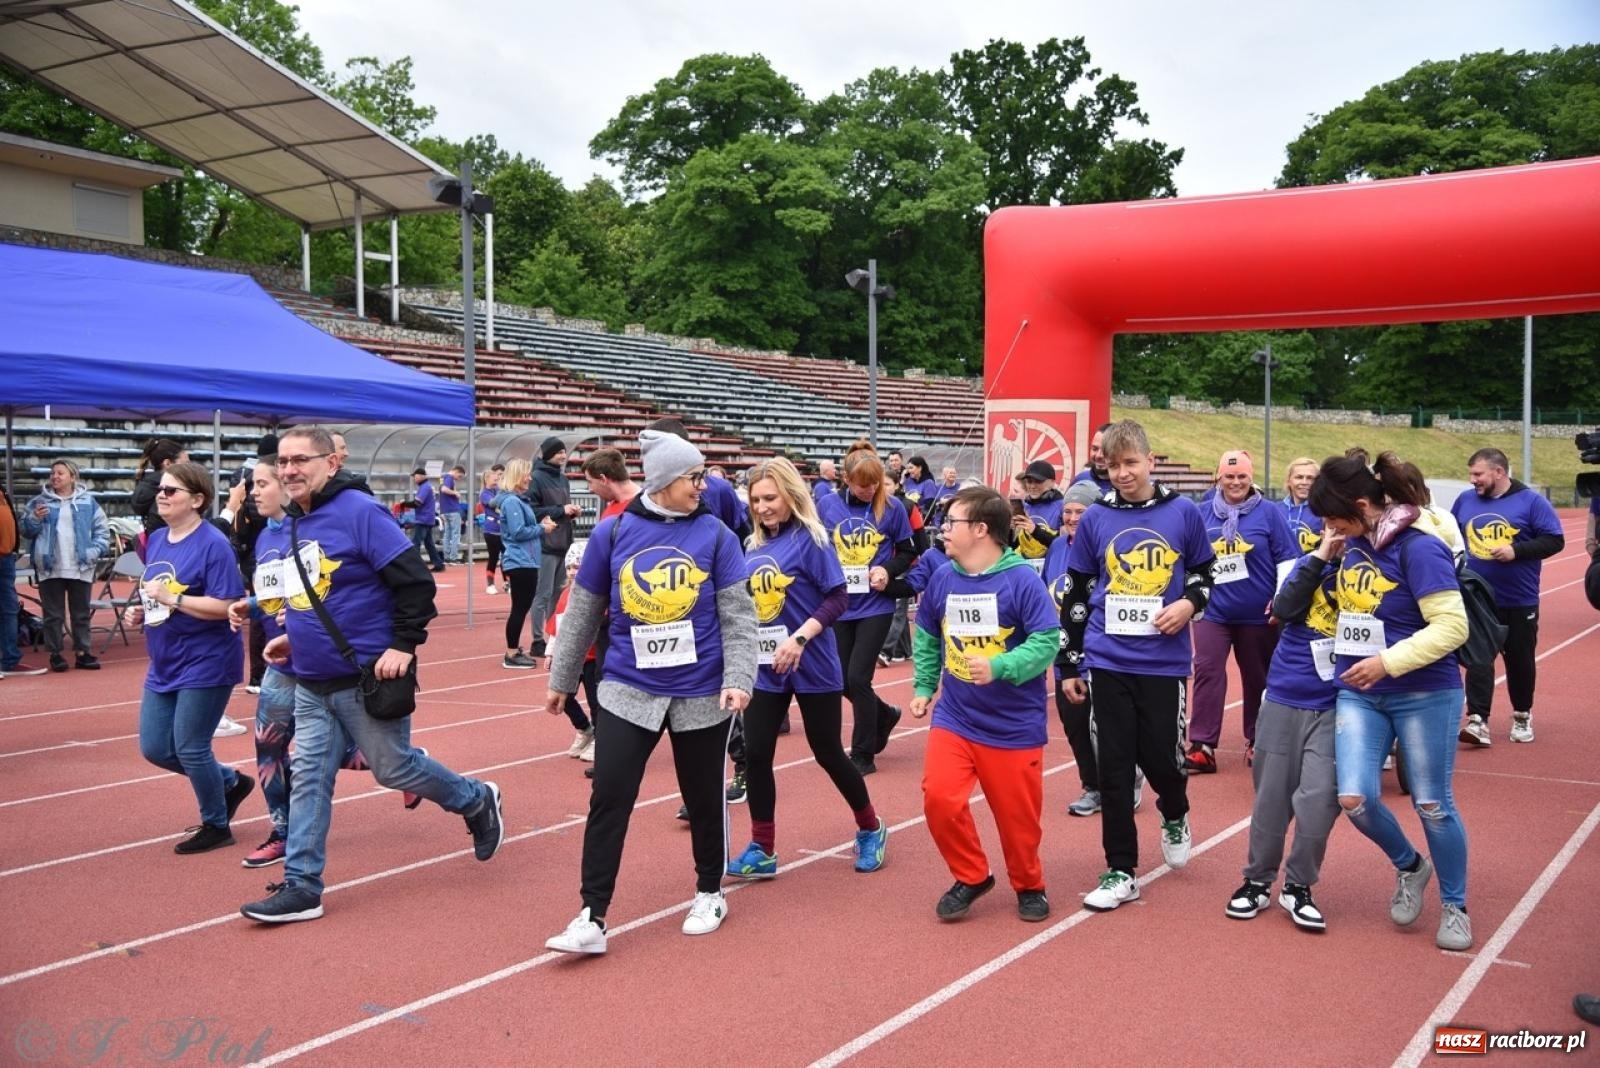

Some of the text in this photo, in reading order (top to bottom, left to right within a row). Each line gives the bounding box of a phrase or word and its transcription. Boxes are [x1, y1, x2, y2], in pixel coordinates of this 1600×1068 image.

[1143, 546, 1165, 571] 10
[262, 574, 278, 588] 126
[664, 564, 690, 591] 10
[625, 583, 664, 614] RACIBORSKI
[958, 609, 981, 623] 118
[1118, 608, 1149, 623] 085
[1344, 627, 1370, 642] 089
[647, 637, 680, 654] 077
[759, 640, 777, 652] 129
